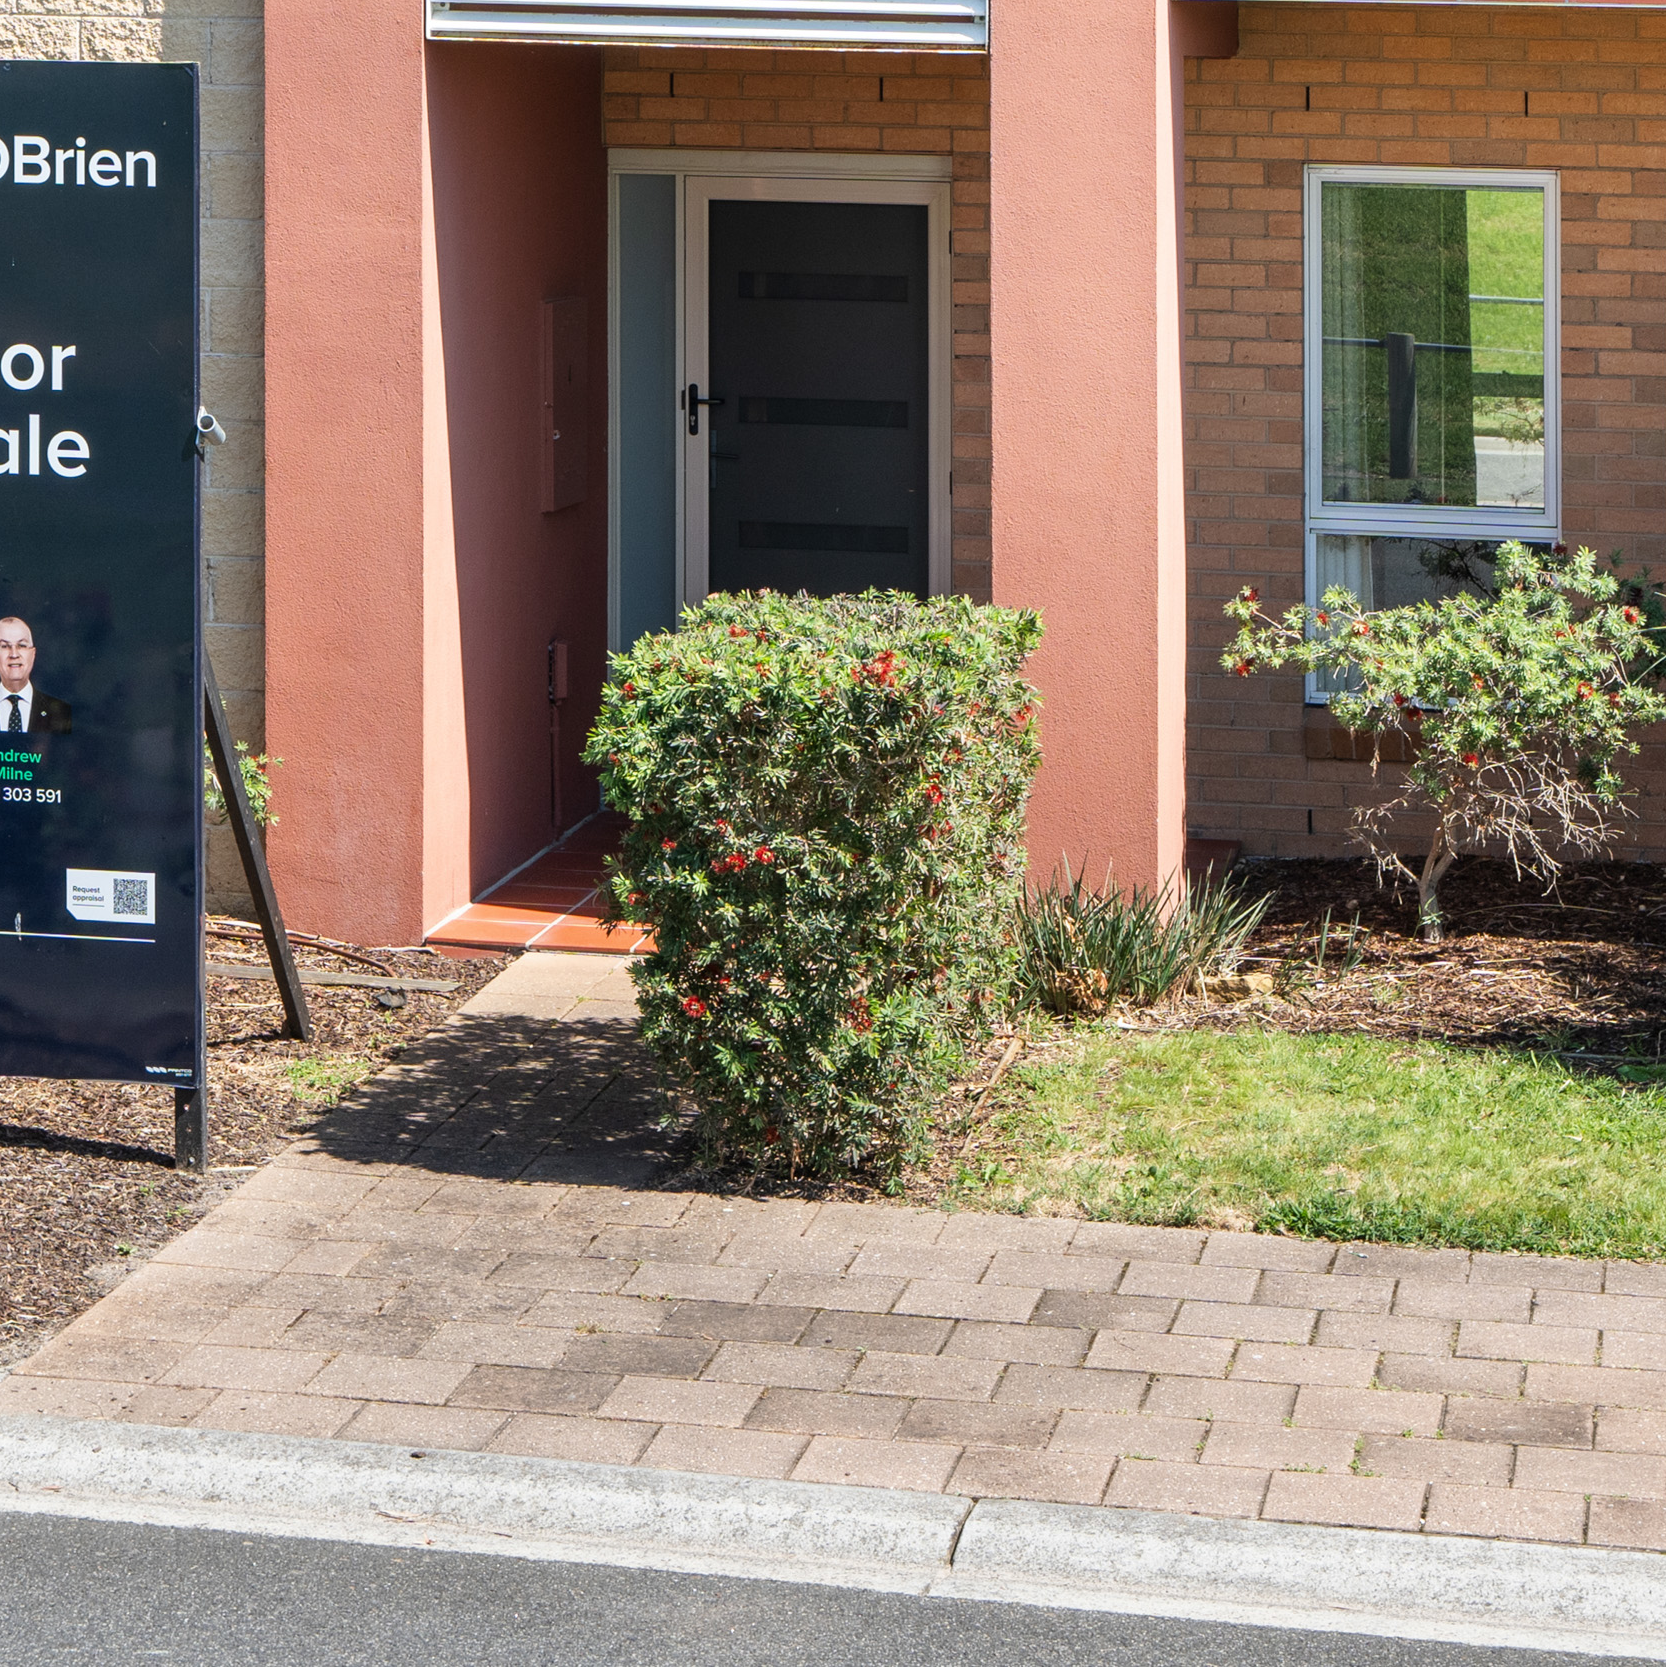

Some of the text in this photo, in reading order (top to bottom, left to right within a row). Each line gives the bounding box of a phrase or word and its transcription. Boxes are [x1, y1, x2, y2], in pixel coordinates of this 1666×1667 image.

[2, 786, 32, 802] 303
[36, 788, 62, 804] 591
[72, 885, 100, 894] Request
[72, 894, 104, 902] appraisal
